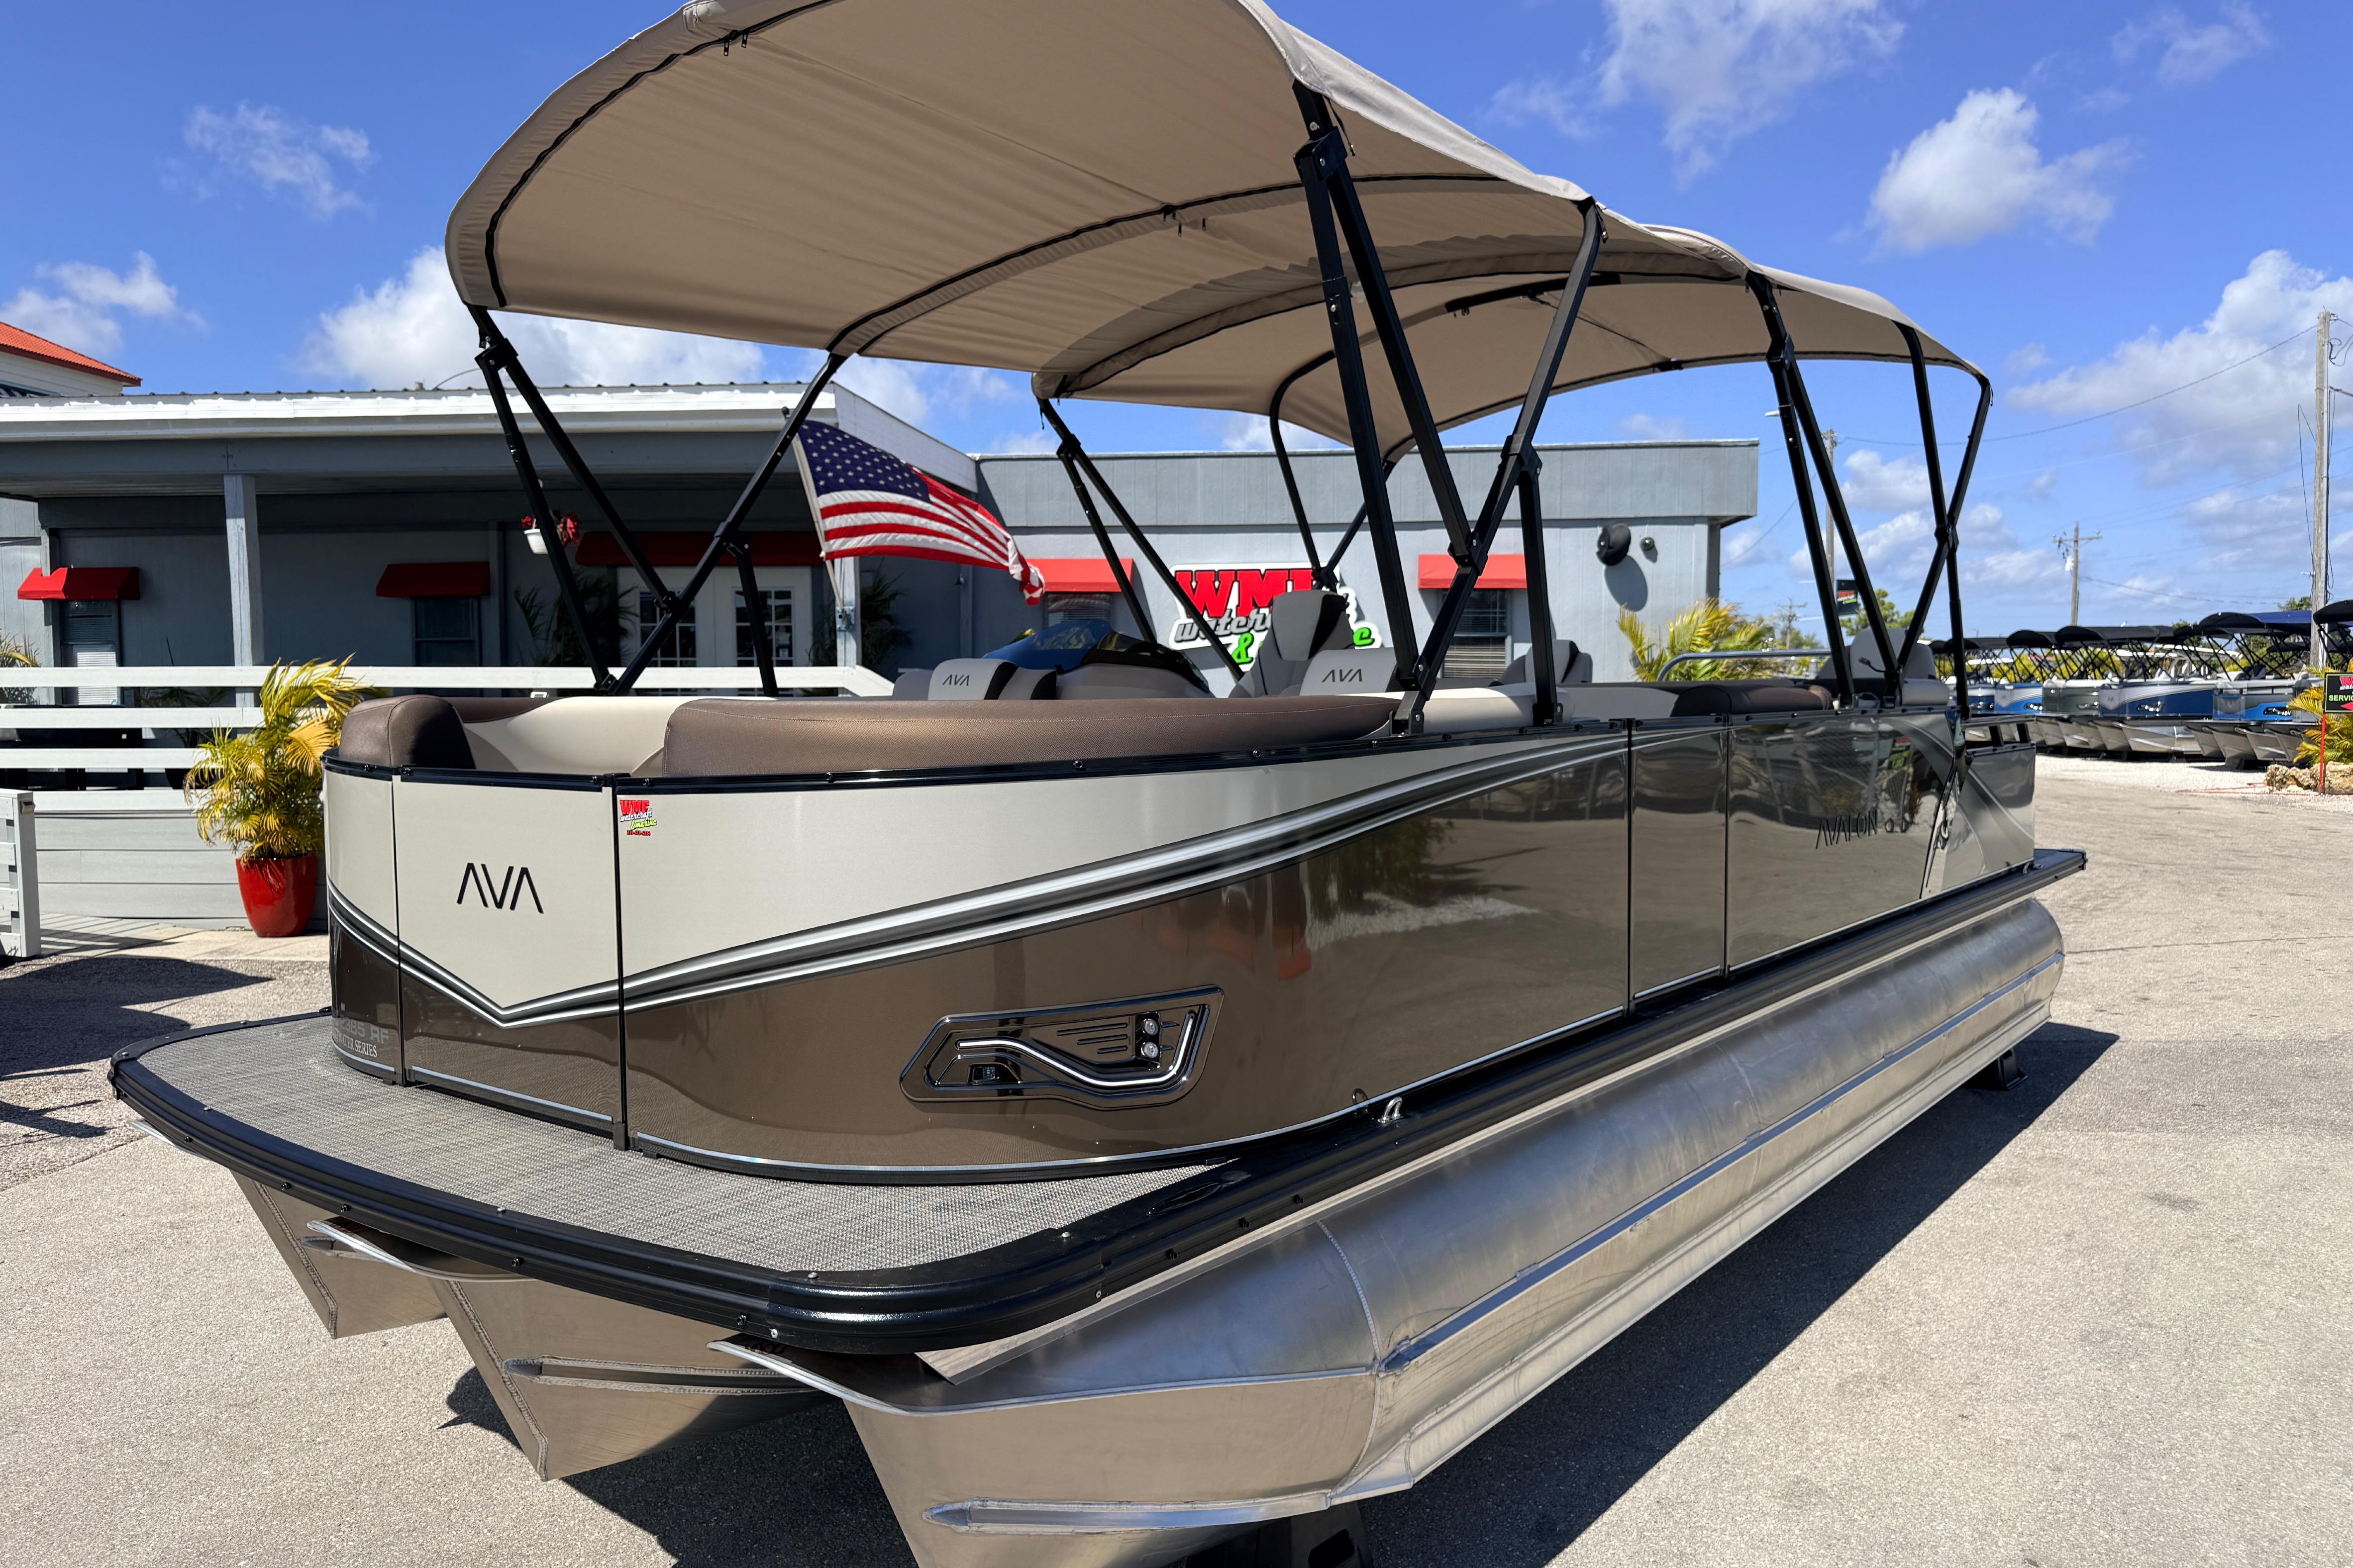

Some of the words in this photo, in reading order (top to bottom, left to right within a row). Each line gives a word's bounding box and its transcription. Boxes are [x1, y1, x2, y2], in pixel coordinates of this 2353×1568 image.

[1231, 632, 1254, 665] &
[942, 674, 970, 686] AVA
[1322, 668, 1362, 683] AVA
[620, 800, 650, 816] WMF
[1816, 808, 1878, 849] AVALON
[457, 863, 544, 914] AVA
[355, 1039, 377, 1058] SERIES
